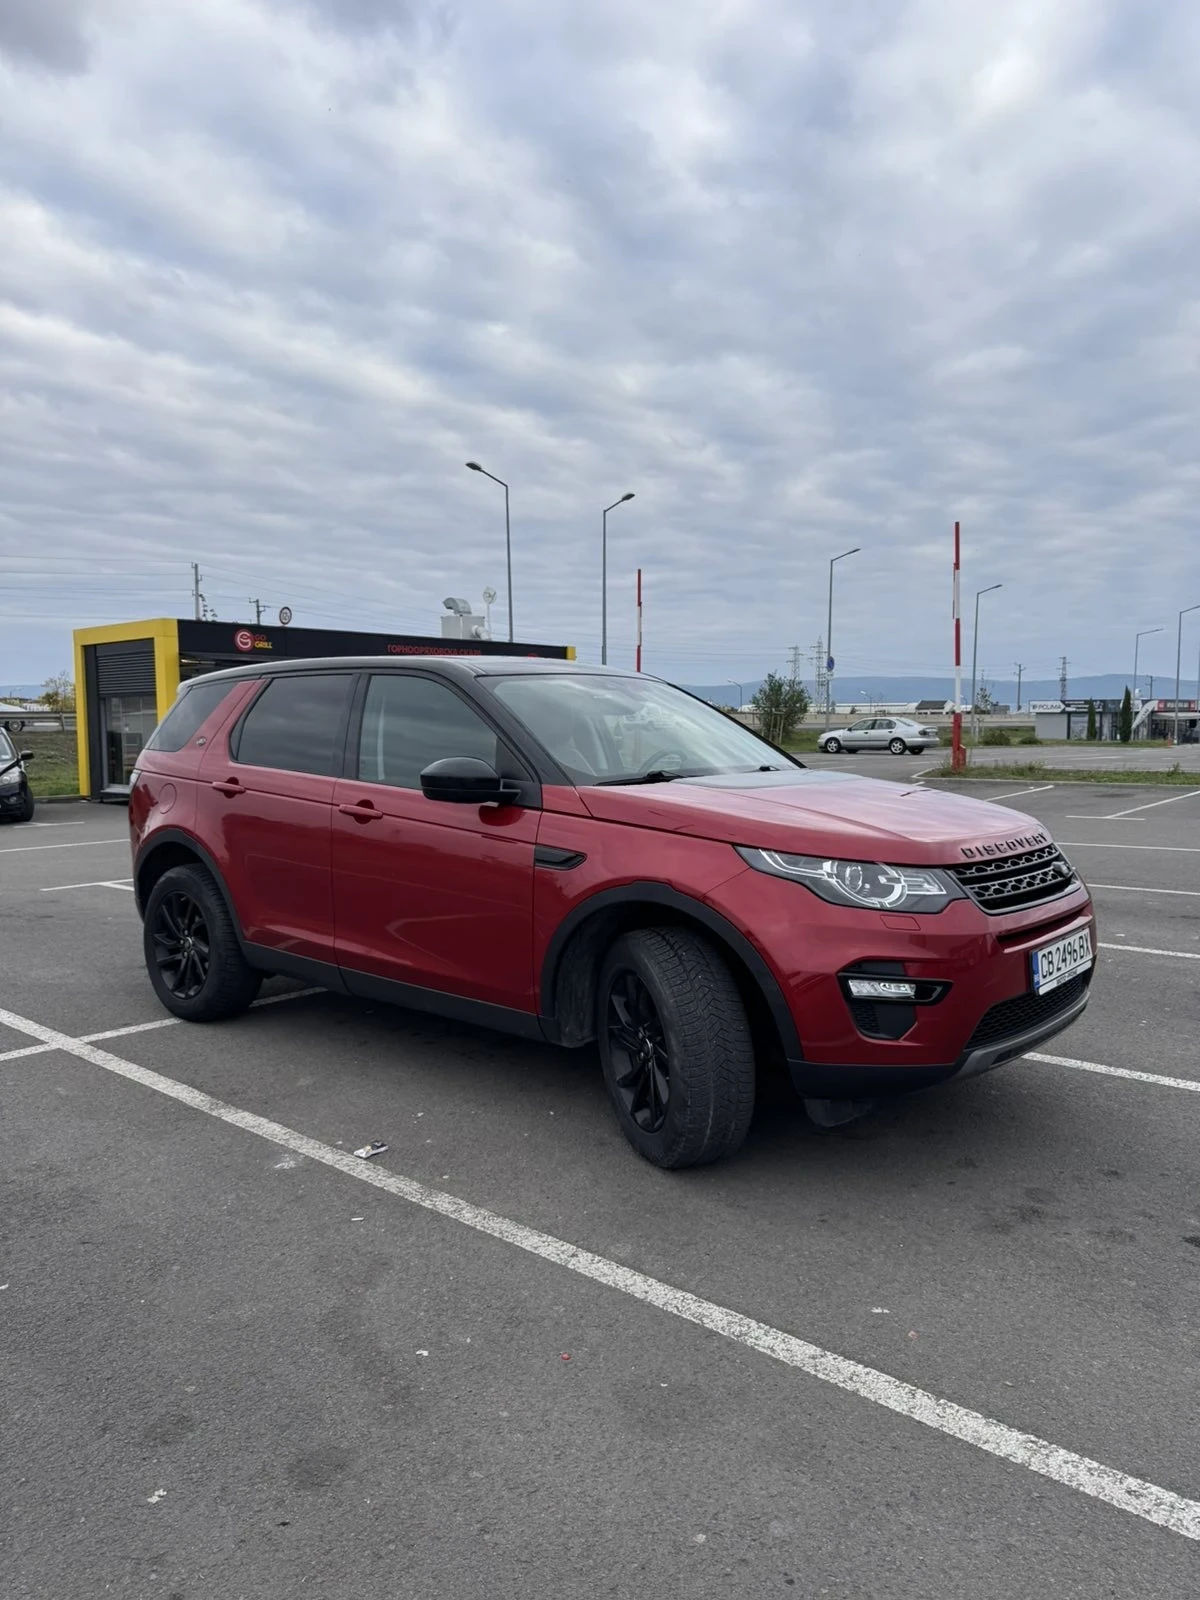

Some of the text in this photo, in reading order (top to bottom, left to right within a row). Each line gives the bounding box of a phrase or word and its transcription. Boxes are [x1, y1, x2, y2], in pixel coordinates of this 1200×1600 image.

[254, 640, 272, 649] GRILL
[960, 832, 1048, 859] DISCOVERY
[1040, 950, 1055, 979] CB
[1055, 938, 1079, 972] 2496
[1078, 931, 1091, 960] BX
